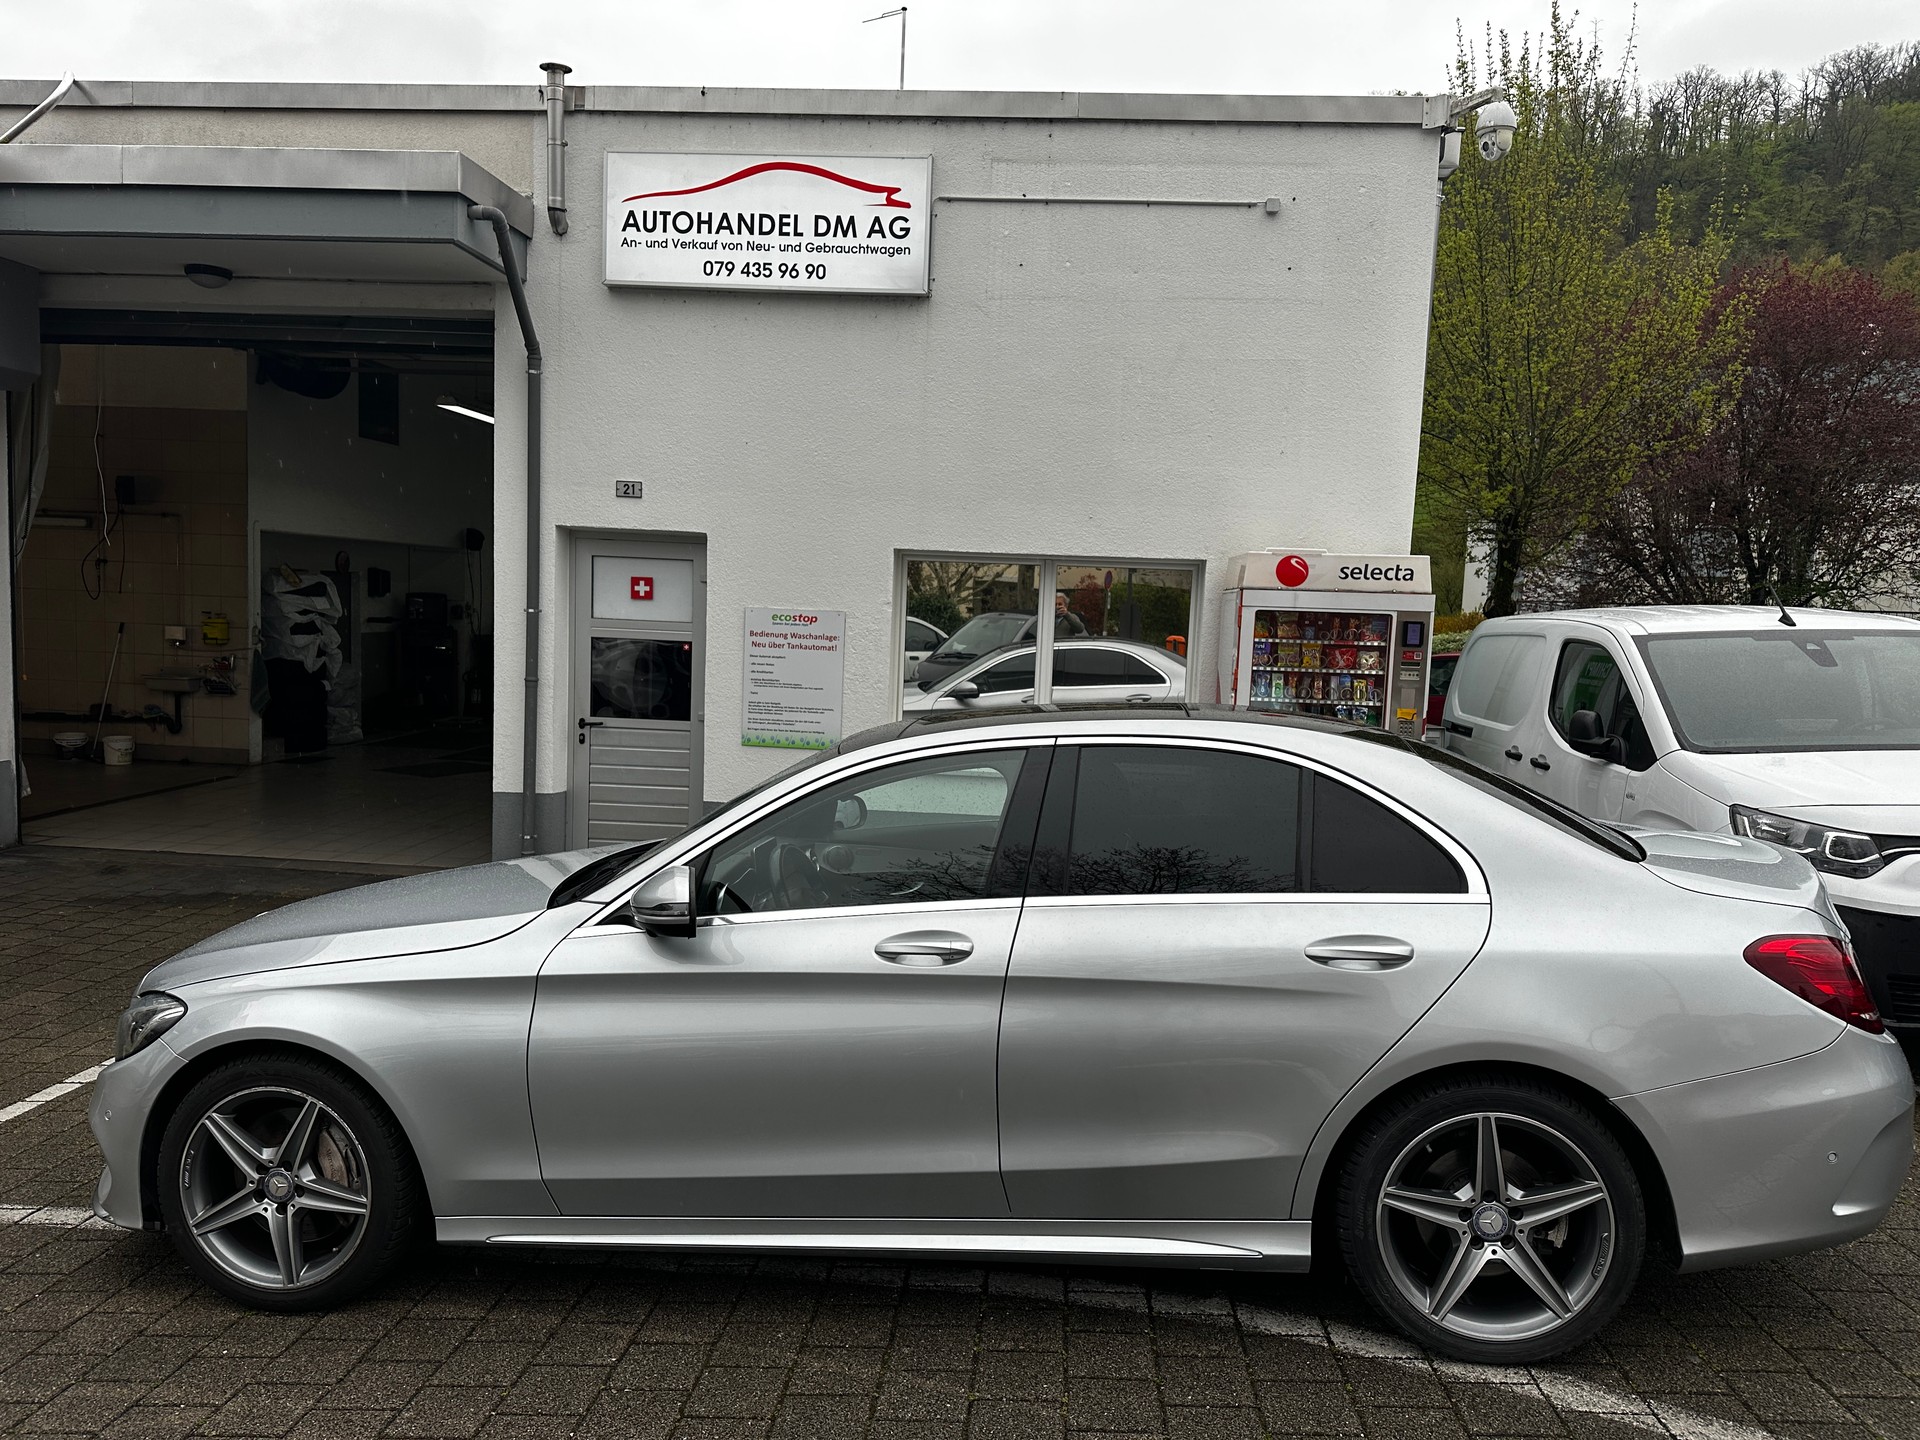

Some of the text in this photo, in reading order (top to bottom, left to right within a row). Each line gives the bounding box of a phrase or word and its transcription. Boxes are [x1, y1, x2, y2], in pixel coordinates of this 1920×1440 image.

[621, 210, 911, 239] AUTOHANDEL DM AG
[621, 237, 911, 257] An- und Verkauf von Neu- und Gebrauchtwagen
[703, 260, 826, 280] 079 435 96 90
[623, 483, 635, 495] 21
[1338, 563, 1414, 581] selecta
[771, 613, 818, 625] ecostop
[749, 630, 840, 642] Bedienung Waschanlage:
[751, 640, 838, 652] Neu über Tankautomat!
